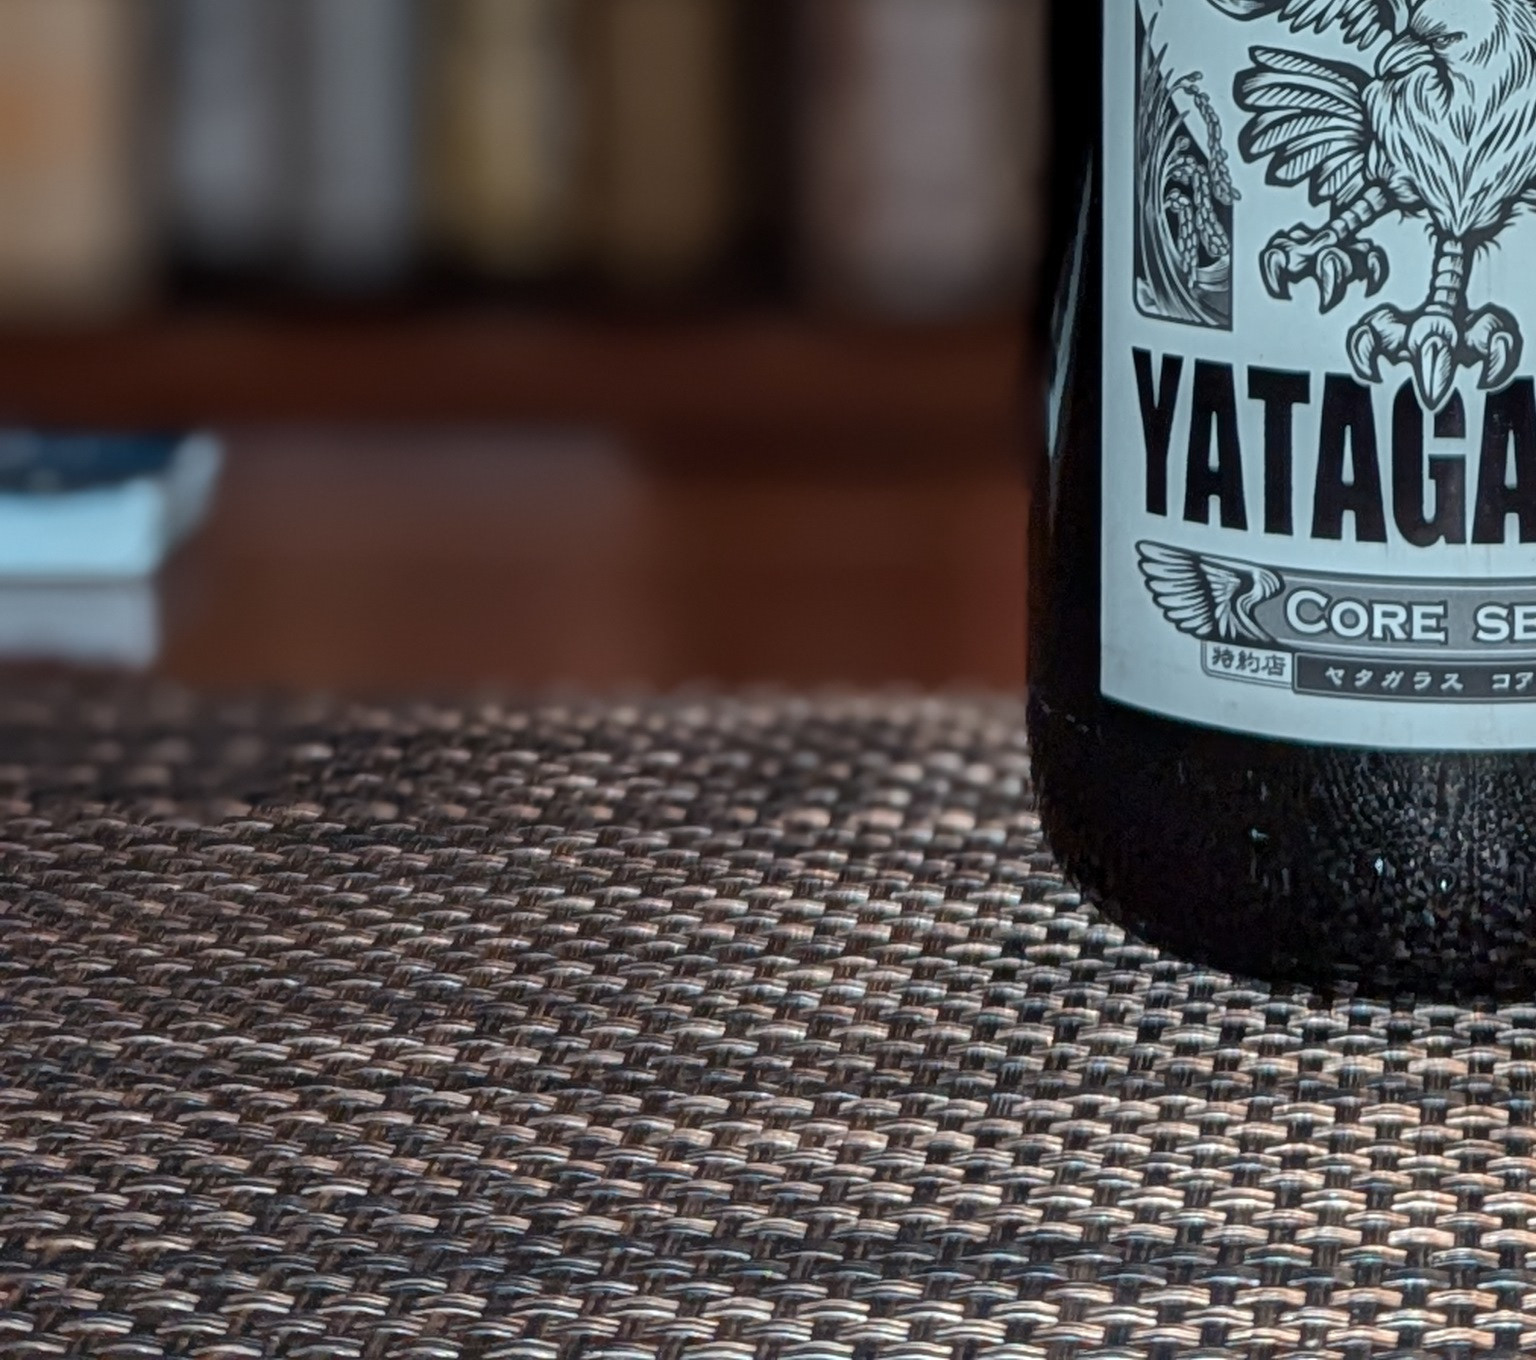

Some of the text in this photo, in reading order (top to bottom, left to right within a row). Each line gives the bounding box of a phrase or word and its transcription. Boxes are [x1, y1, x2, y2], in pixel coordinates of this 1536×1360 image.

[1284, 590, 1447, 644] CORE
[1211, 647, 1287, 677] 特約店
[1324, 666, 1465, 692] ヤタガラス
